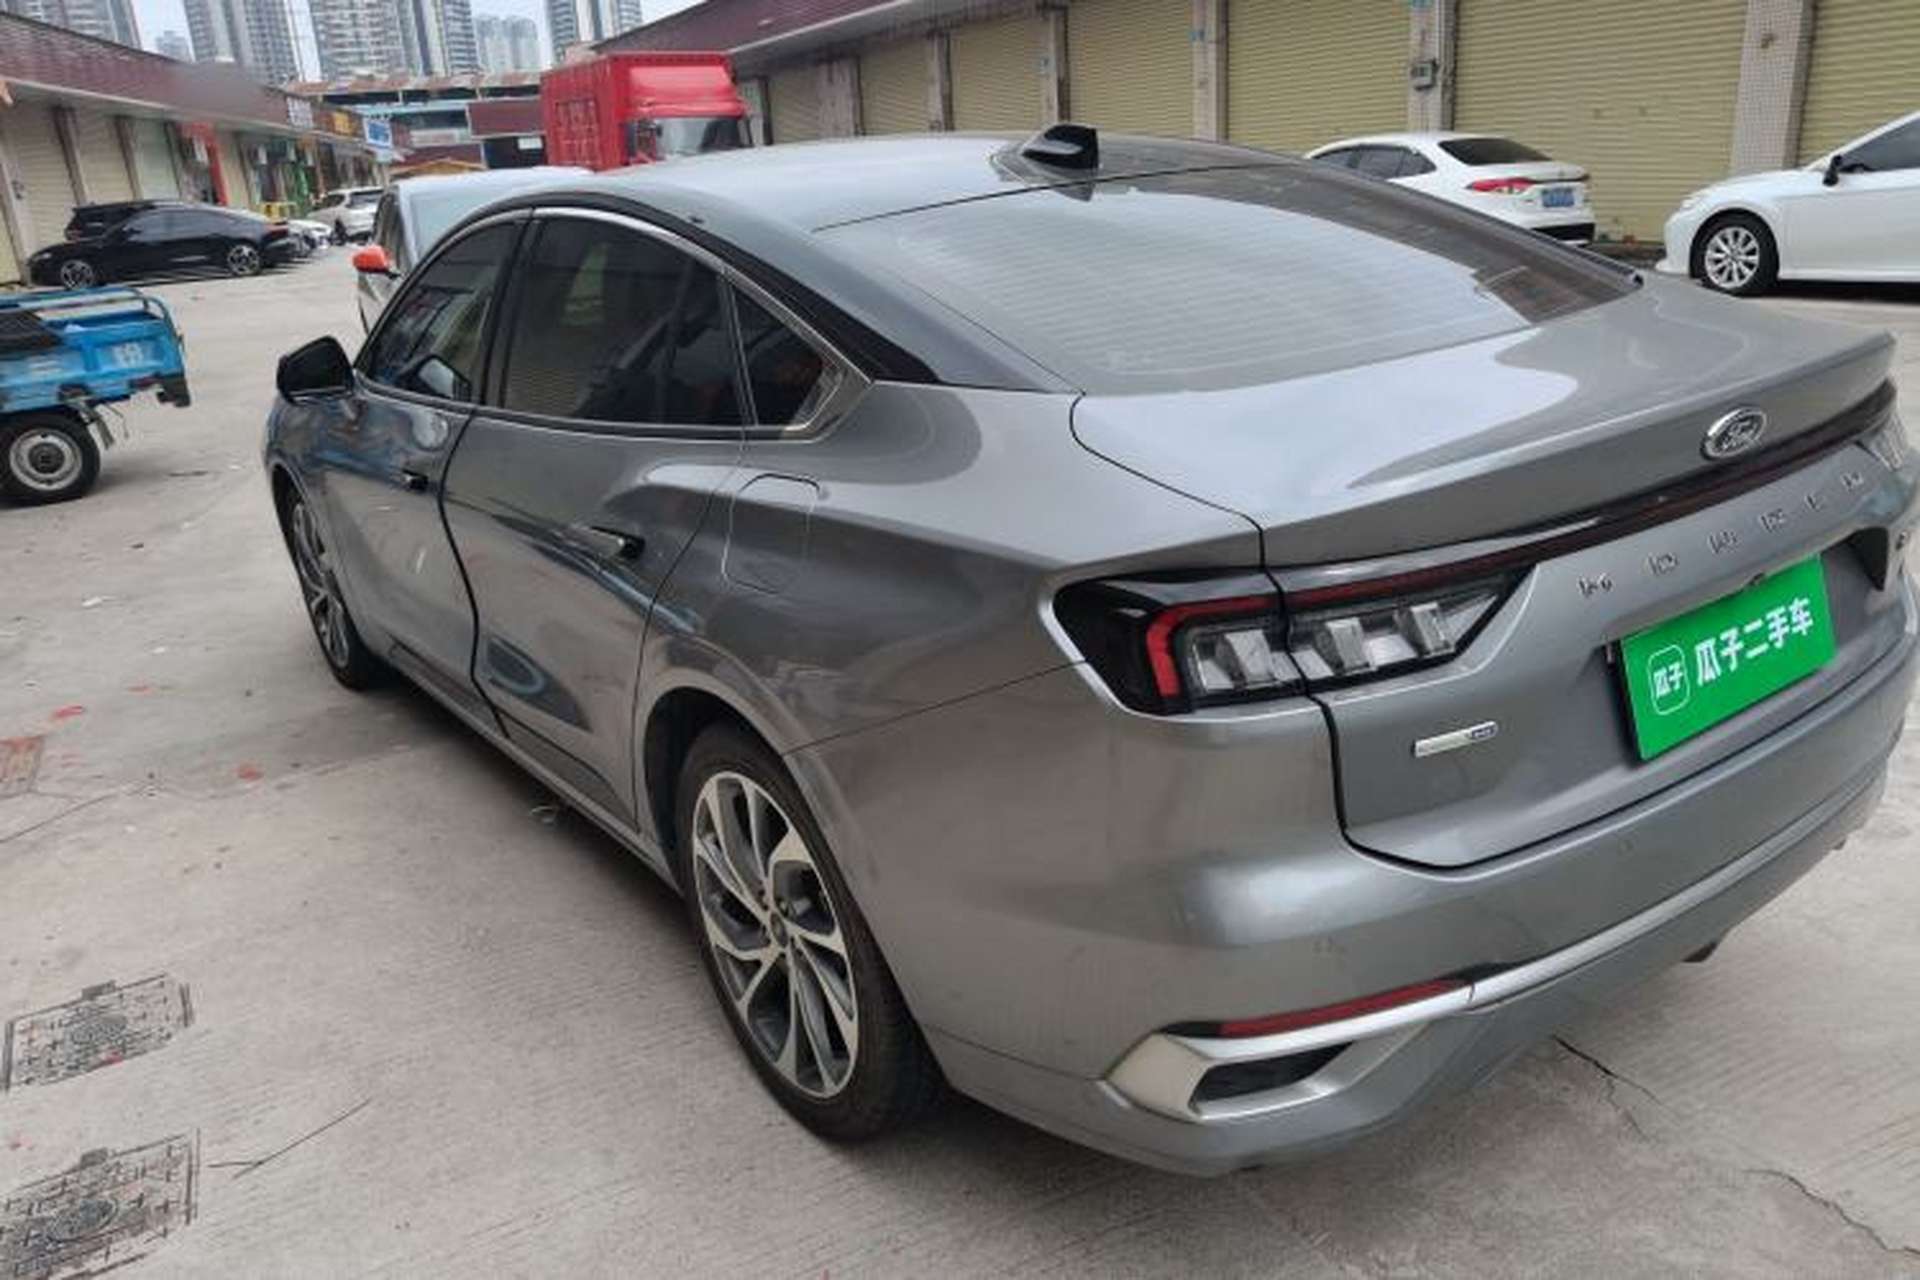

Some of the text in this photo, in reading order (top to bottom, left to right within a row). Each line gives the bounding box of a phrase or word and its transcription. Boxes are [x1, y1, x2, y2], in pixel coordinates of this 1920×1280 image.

[1694, 597, 1814, 686] 瓜子二手车
[1652, 661, 1684, 699] 瓜子
